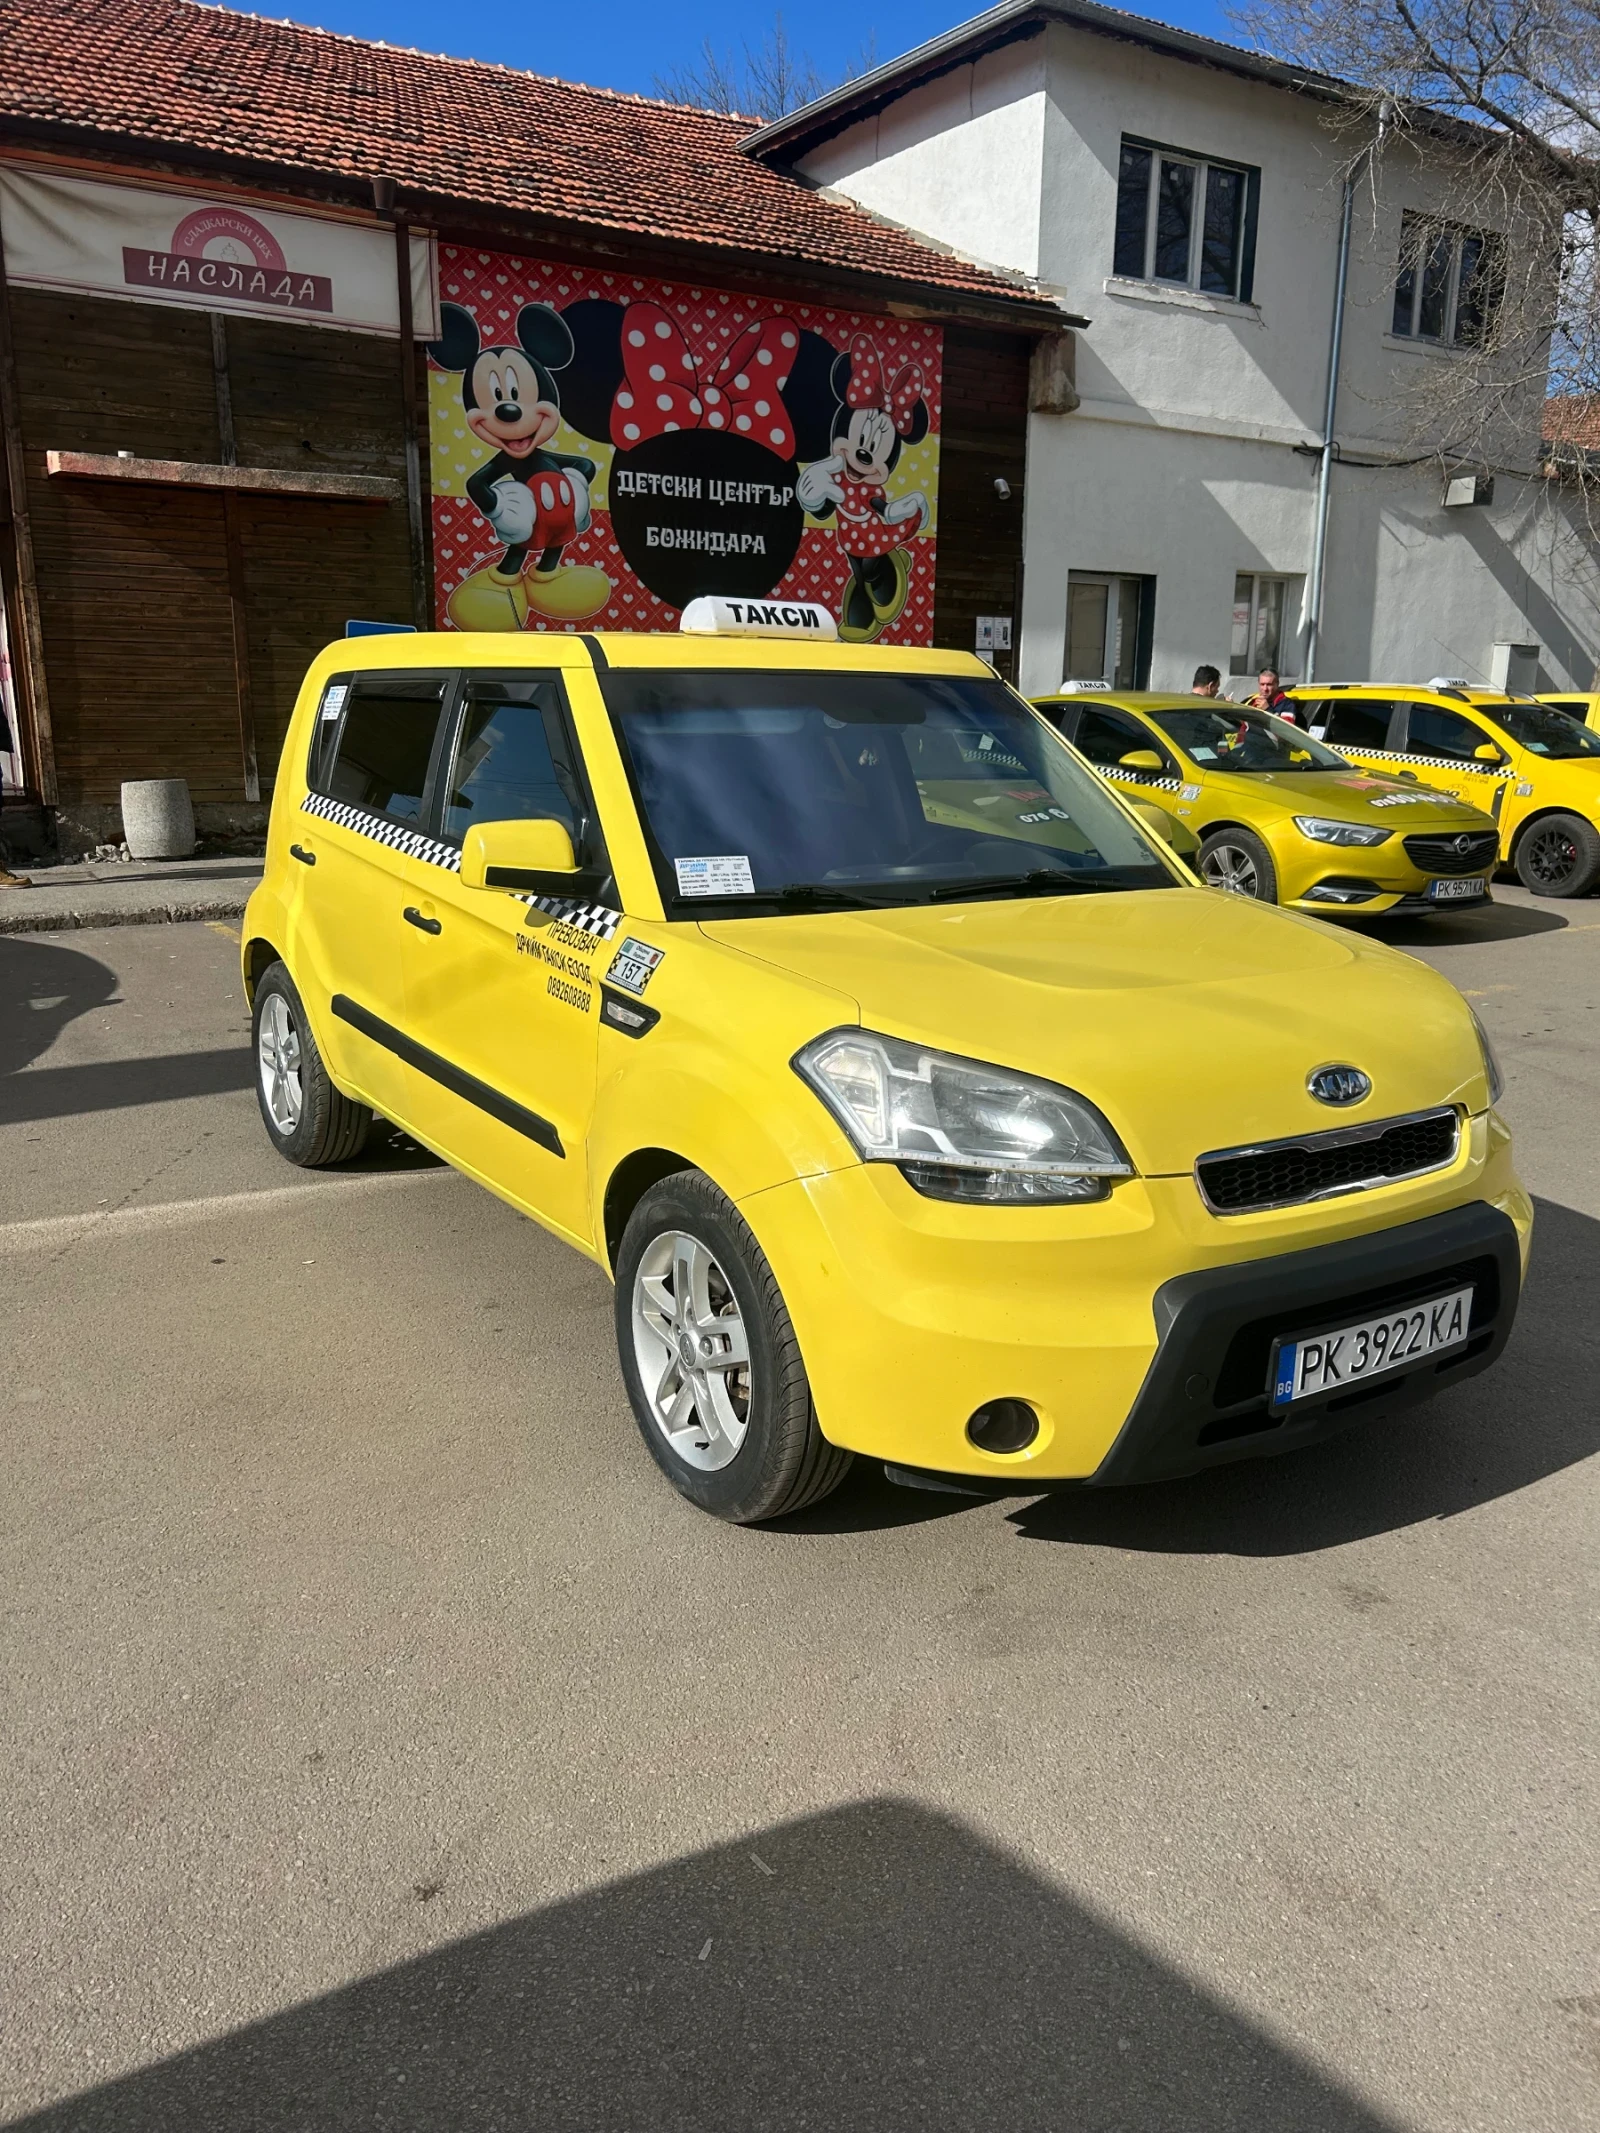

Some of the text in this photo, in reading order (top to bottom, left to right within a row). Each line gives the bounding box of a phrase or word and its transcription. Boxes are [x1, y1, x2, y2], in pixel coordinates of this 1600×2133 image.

[183, 217, 273, 259] СЛАДКАРСКИ ЦЕХ
[147, 255, 316, 306] НАСЛАДА
[616, 470, 795, 507] ДЕТСКИ ЦЕНТЪР
[645, 526, 767, 557] БОЖИДАРА
[725, 602, 820, 629] ТАКСИ
[1019, 812, 1050, 823] 076
[1437, 881, 1450, 897] PK
[1452, 881, 1472, 896] 9571
[546, 919, 602, 957] ПРЕВОЗВАЧ
[541, 944, 568, 973] ТАКСИ
[567, 957, 593, 989] ЕООД
[621, 960, 643, 982] 157
[1297, 1297, 1463, 1391] PK 3922 KA
[1276, 1381, 1293, 1396] BG
